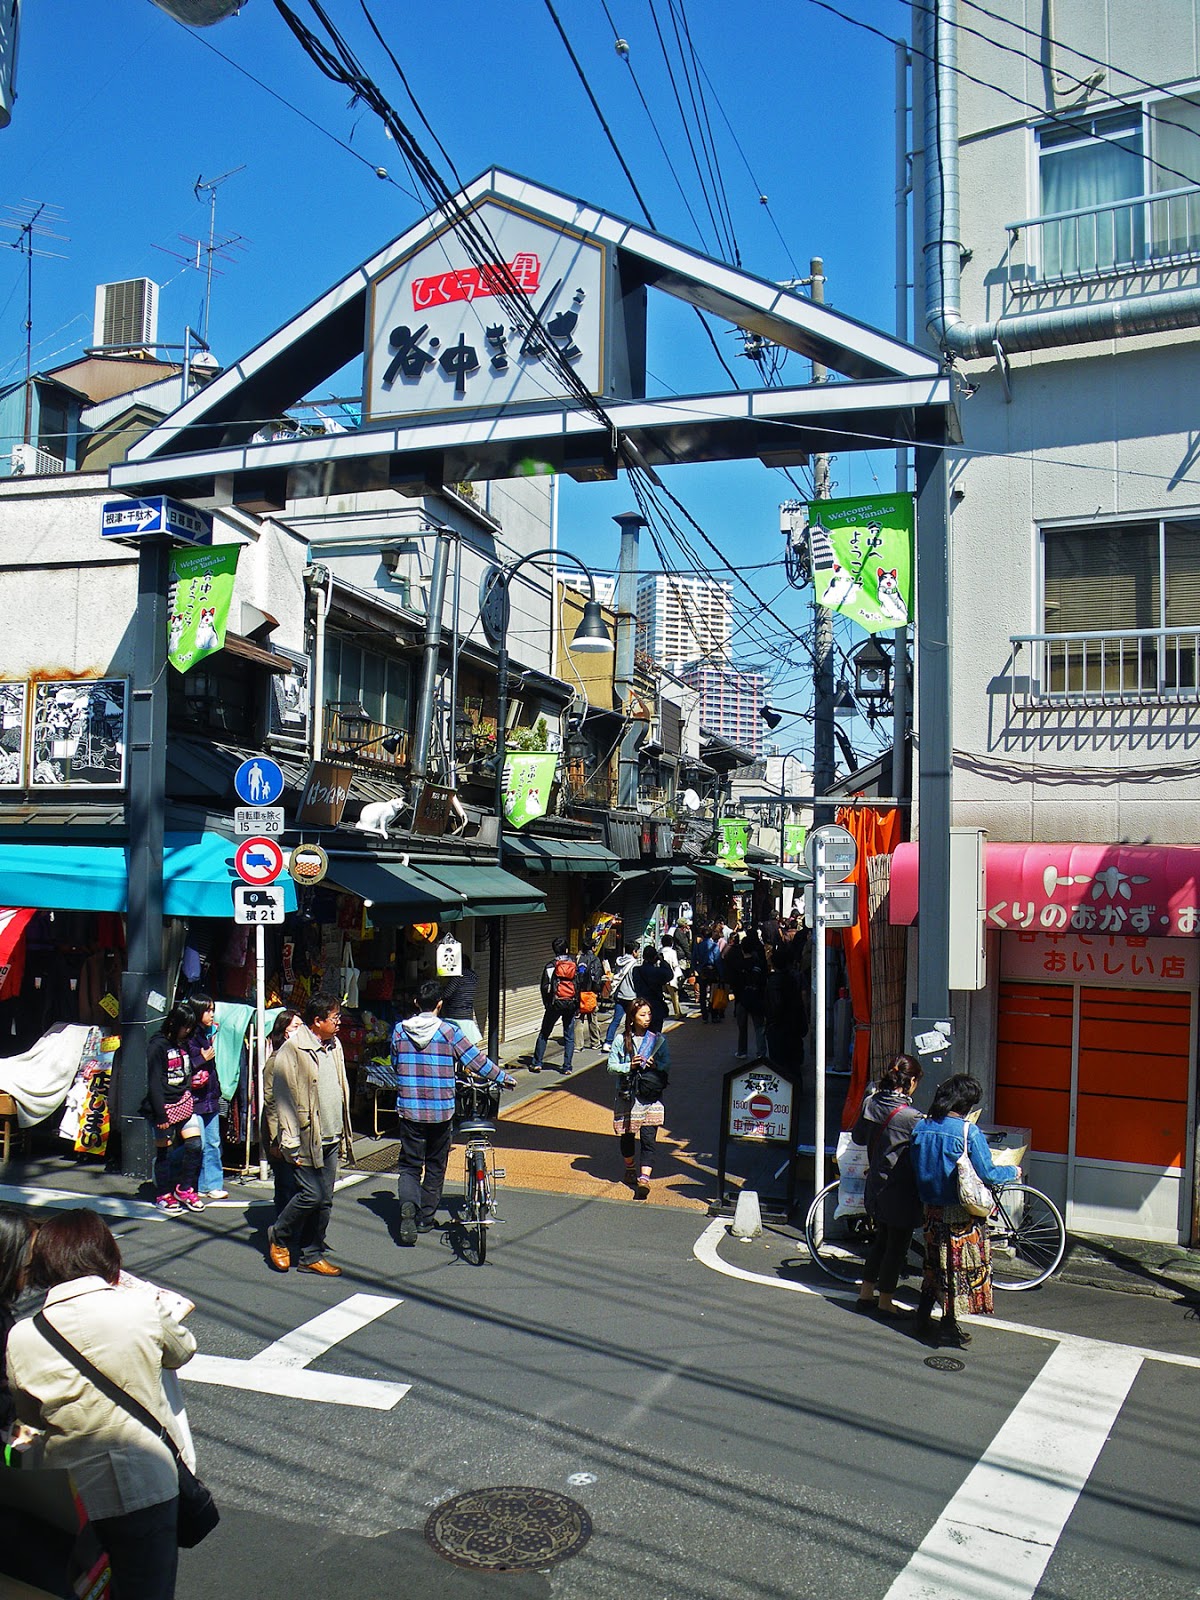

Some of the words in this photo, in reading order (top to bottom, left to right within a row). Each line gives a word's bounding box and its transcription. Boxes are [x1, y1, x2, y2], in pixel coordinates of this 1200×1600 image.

[383, 278, 583, 393] 谷中ぎんざ
[106, 509, 153, 525] 根津・千駄木
[828, 505, 873, 521] Welcome
[846, 515, 857, 524] to
[860, 506, 895, 520] Yanaka
[867, 520, 883, 559] 谷中へ
[180, 554, 212, 569] Welcome
[200, 555, 226, 569] Yanaka
[850, 531, 864, 589] ようこそ
[199, 569, 214, 601] 谷中へ
[237, 811, 281, 820] 自転車を除く
[240, 822, 250, 832] 15
[265, 822, 279, 832] 20
[1043, 865, 1151, 900] トーホー
[1043, 950, 1186, 979] おいしい店
